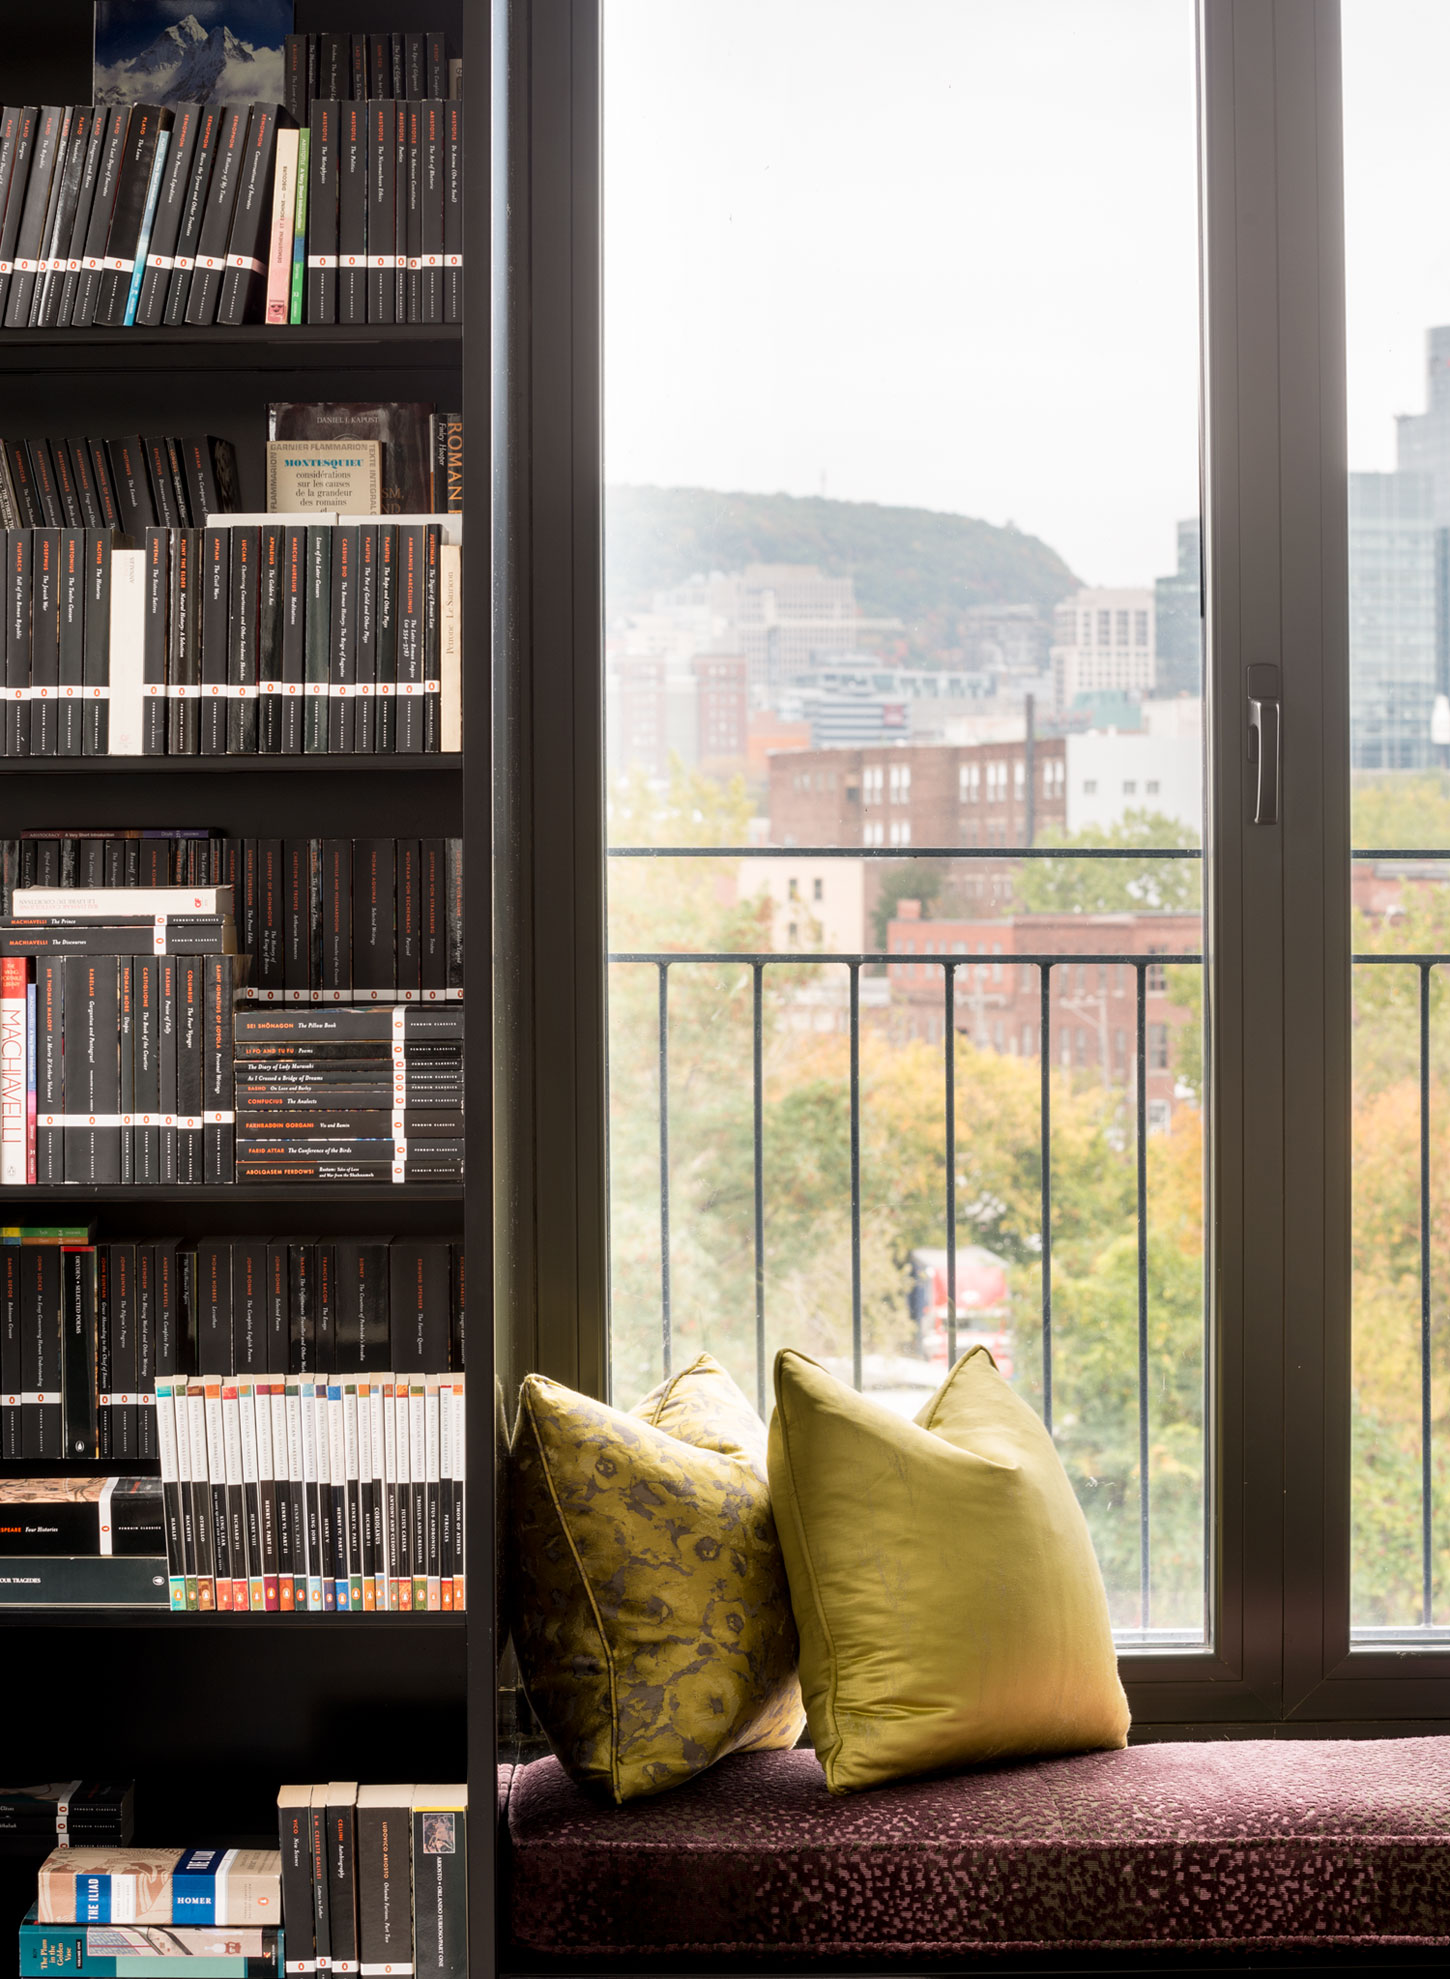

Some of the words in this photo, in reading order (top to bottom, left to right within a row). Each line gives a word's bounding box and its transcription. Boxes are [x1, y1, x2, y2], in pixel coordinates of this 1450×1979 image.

[94, 116, 102, 135] PLATO
[140, 116, 148, 135] PLATO
[179, 114, 190, 147] XENOPHON
[256, 113, 267, 147] XENOPHON
[173, 160, 182, 178] Persian
[250, 150, 261, 183] Conversations
[168, 178, 179, 203] Expedition
[246, 190, 254, 210] Socrates
[438, 422, 447, 442] Finley
[270, 443, 309, 451] GARNIER
[310, 443, 368, 451] FLAMMARION
[439, 443, 447, 466] Hooper
[284, 459, 364, 469] MONTESQUIEU
[448, 422, 462, 501] ROMAN
[270, 452, 278, 510] FLAMMARION
[296, 471, 351, 479] considérations
[296, 489, 306, 497] de
[307, 489, 315, 497] la
[317, 489, 352, 499] grandeur
[300, 498, 314, 506] des
[316, 498, 347, 506] romains
[41, 584, 49, 601] Jewish
[163, 1022, 171, 1034] Folly
[185, 1029, 193, 1048] Voyages
[2, 1009, 22, 1143] MACHIAVELLI
[297, 1147, 324, 1155] Conference
[456, 1522, 461, 1531] OF
[337, 1844, 345, 1878] Autobiography
[87, 1878, 99, 1901] ILIAD
[176, 1896, 212, 1905] HOMER
[87, 1903, 99, 1920] THE
[383, 1922, 391, 1933] Part
[40, 1938, 48, 1956] Plum
[48, 1944, 56, 1956] the
[56, 1942, 64, 1966] Golden
[64, 1946, 72, 1962] Vase
[40, 1956, 48, 1969] The
